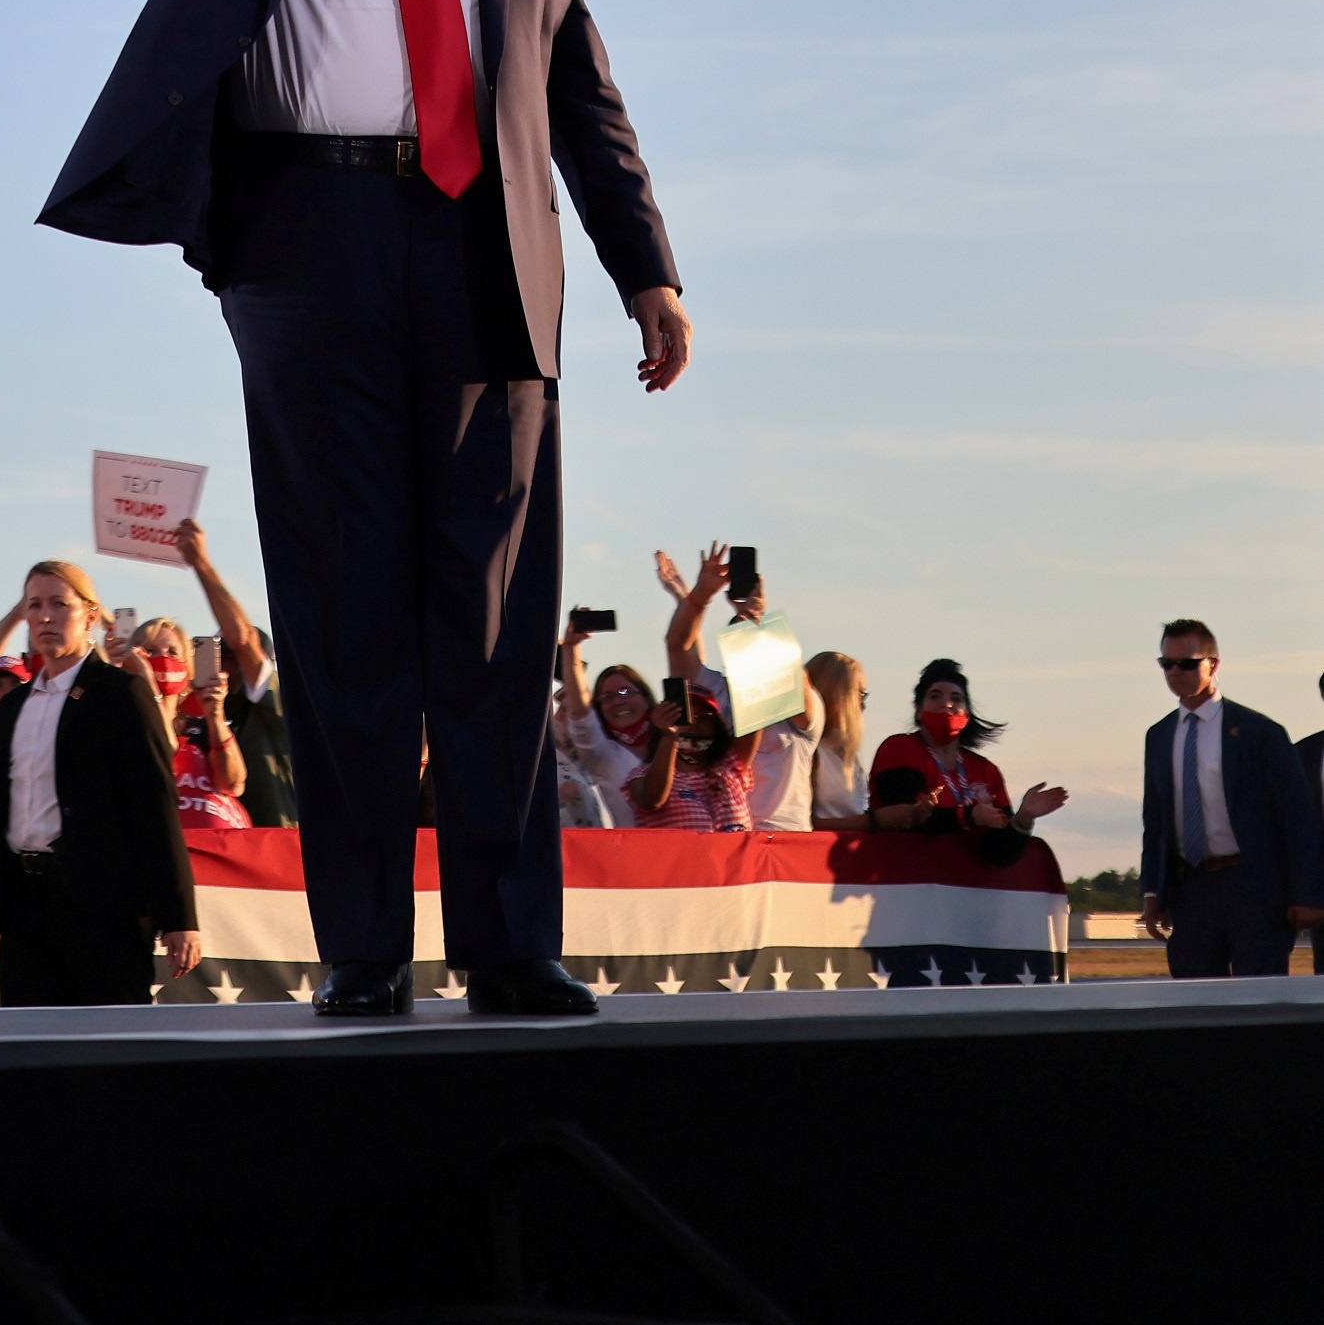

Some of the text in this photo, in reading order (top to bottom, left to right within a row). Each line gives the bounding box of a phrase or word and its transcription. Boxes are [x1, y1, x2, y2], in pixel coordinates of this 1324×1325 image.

[121, 475, 163, 495] TEXT
[113, 498, 167, 520] TRUMP
[106, 520, 128, 539] TO
